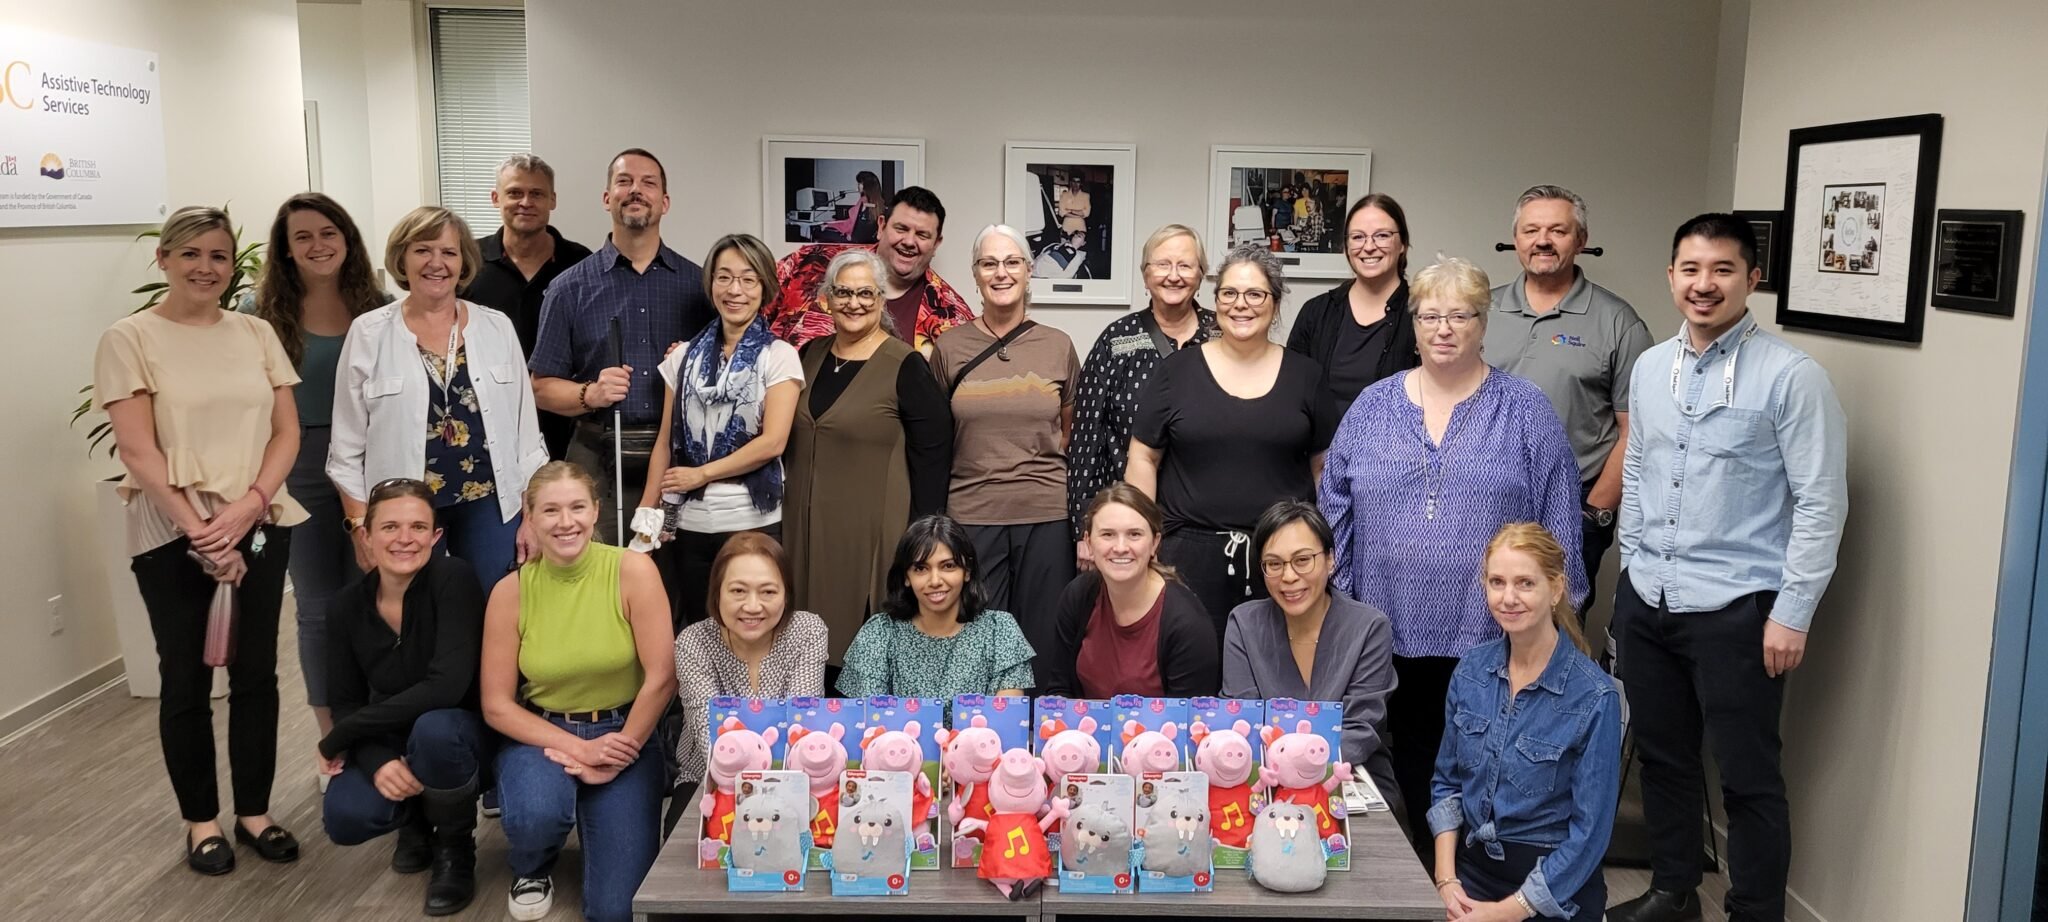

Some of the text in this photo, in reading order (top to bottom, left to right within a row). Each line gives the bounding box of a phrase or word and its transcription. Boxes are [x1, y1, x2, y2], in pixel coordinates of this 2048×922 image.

[41, 72, 151, 105] Assistive Technology
[42, 95, 90, 116] Services
[15, 192, 31, 200] funded
[46, 192, 72, 200] Government
[77, 192, 93, 200] Canada
[17, 202, 37, 210] Province
[788, 873, 798, 881] 0+
[891, 877, 902, 885] 0+
[1198, 875, 1208, 883] 0+
